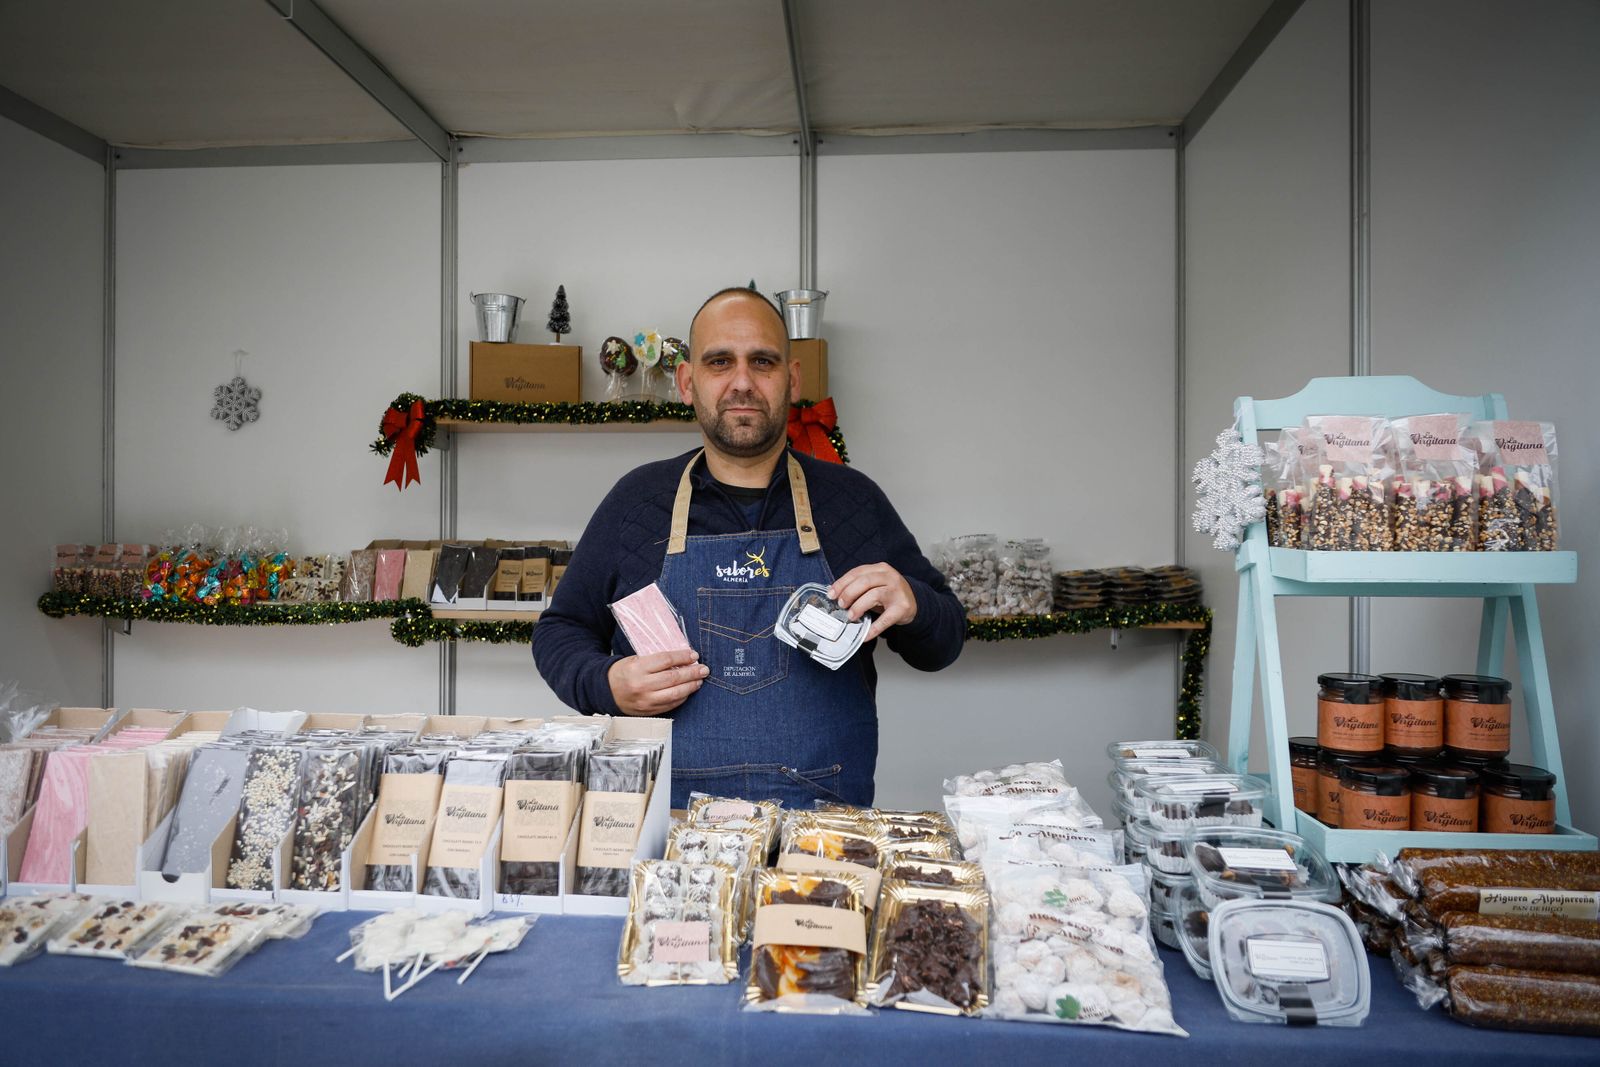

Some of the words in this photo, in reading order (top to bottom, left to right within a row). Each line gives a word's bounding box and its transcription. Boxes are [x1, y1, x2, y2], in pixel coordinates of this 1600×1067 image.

[1324, 434, 1370, 448] Virgitana
[1336, 432, 1346, 440] La
[1410, 434, 1456, 446] Virgitana
[1507, 436, 1518, 444] La
[1495, 438, 1544, 452] Virgitana
[716, 560, 771, 579] sabores
[517, 800, 559, 812] Virgitana
[446, 806, 488, 819] Virgitana
[384, 814, 426, 826] Virgitana
[593, 816, 635, 828] Virgitana
[999, 830, 1022, 840] La
[1028, 830, 1096, 842] Alpujarra
[1484, 894, 1528, 904] Higuera
[1532, 894, 1594, 904] Alpujarreña
[656, 936, 708, 948] Virgitana
